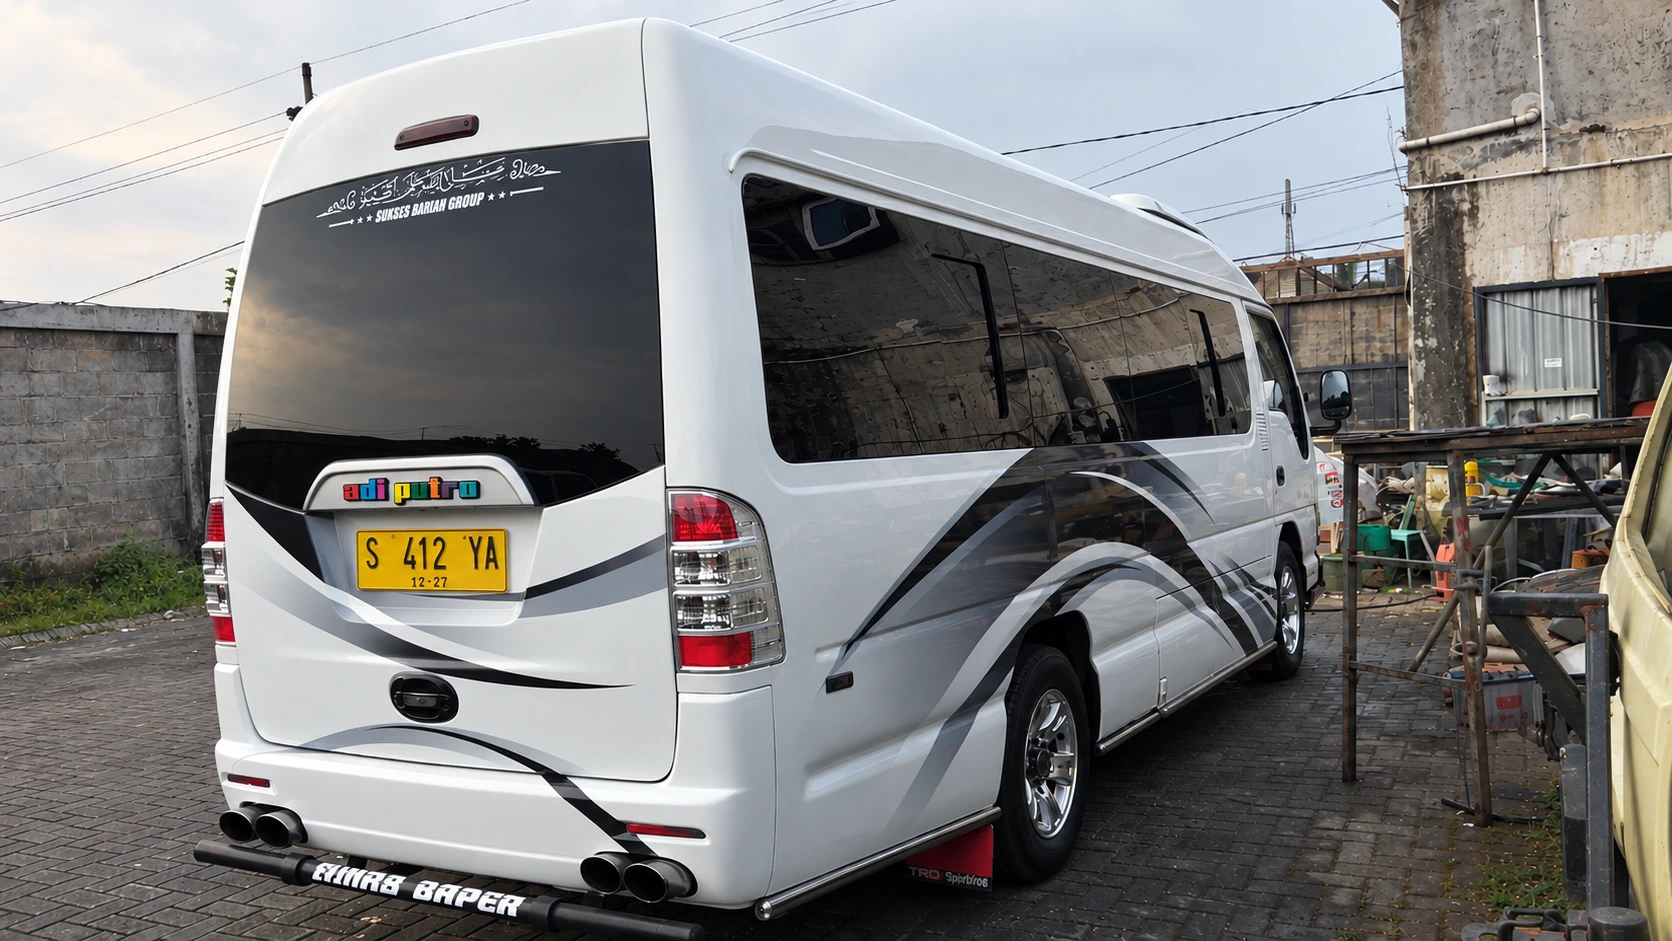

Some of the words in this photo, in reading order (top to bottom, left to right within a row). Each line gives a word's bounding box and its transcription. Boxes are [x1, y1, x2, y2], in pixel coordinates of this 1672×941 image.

[375, 205, 411, 223] SUKSES
[448, 192, 485, 210] GROUP
[343, 478, 389, 501] adi
[394, 477, 480, 505] putro
[366, 537, 379, 569] S
[404, 537, 446, 570] 412
[469, 536, 499, 570] YA
[412, 577, 447, 588] 12-27
[909, 866, 940, 880] TRD
[413, 880, 526, 917] BAPER
